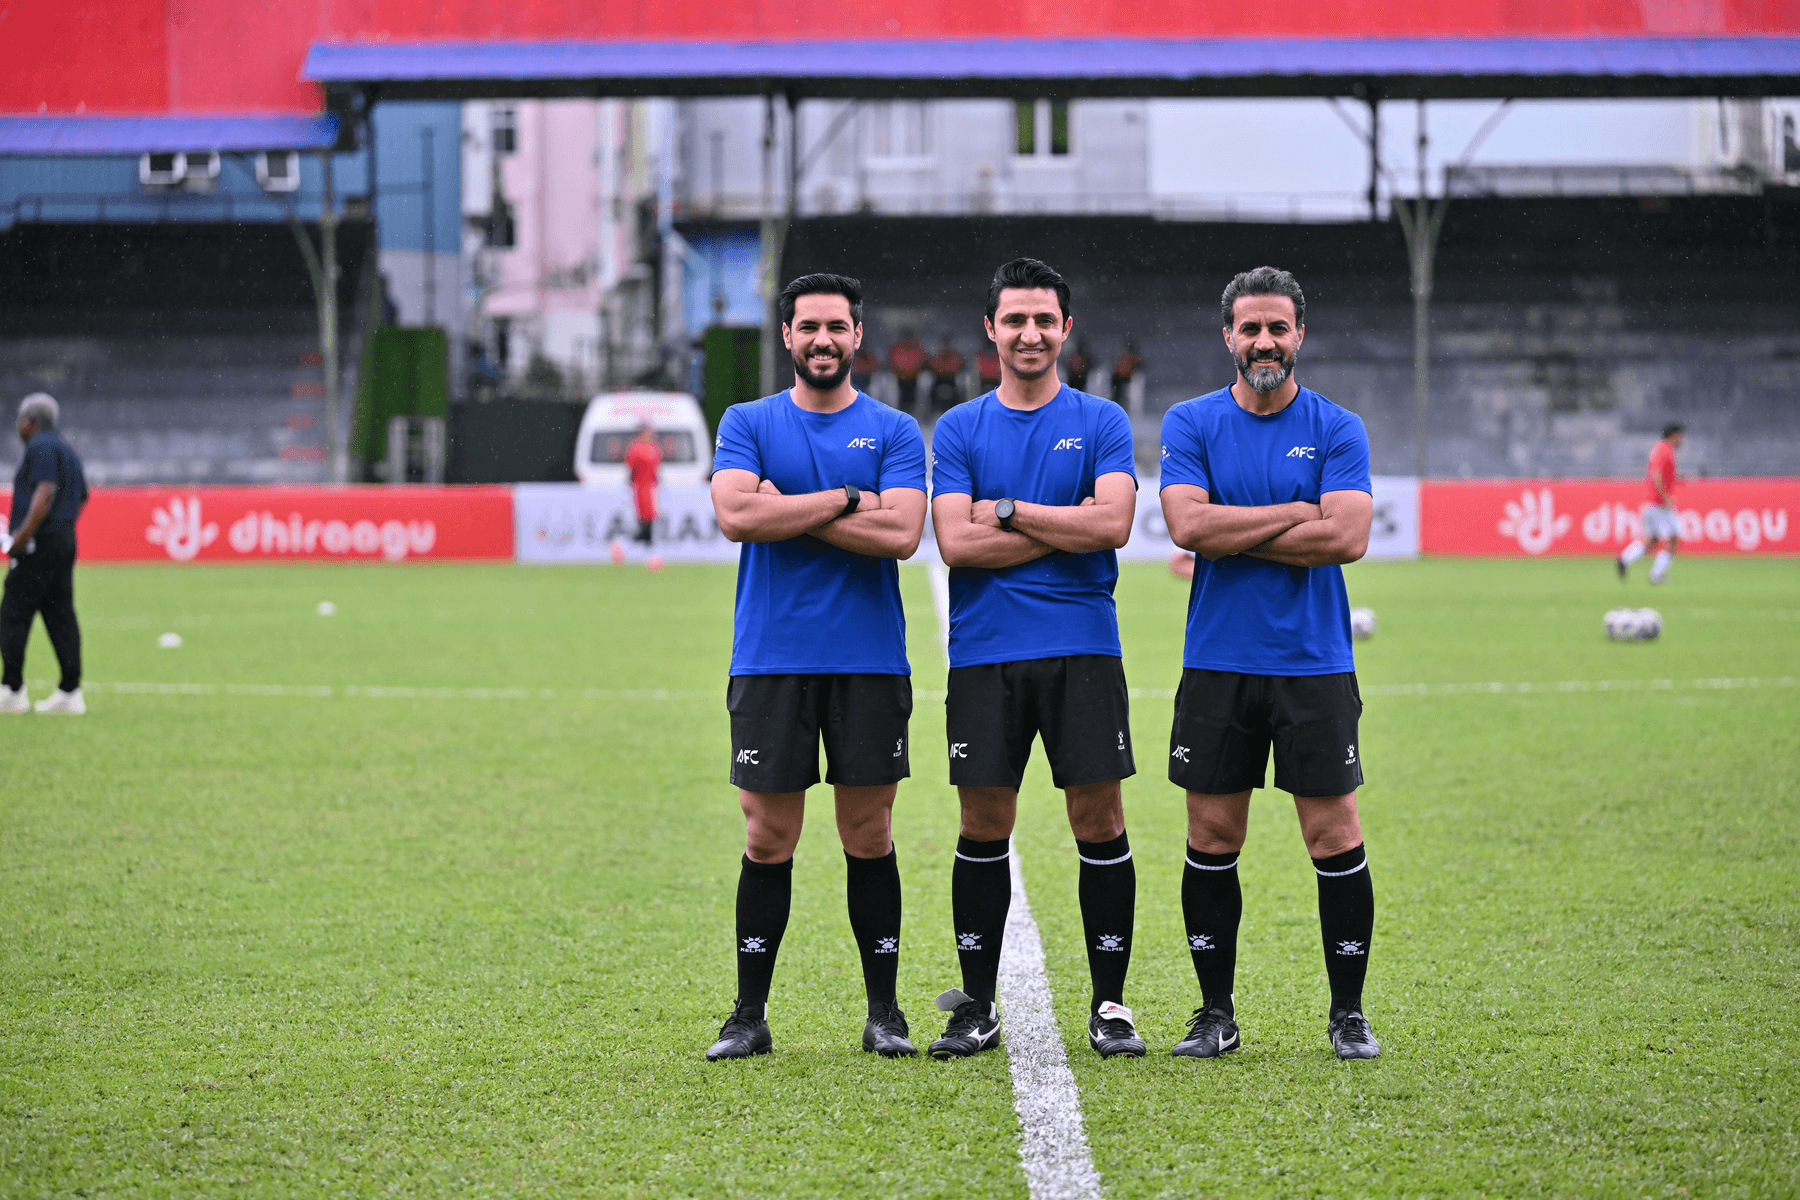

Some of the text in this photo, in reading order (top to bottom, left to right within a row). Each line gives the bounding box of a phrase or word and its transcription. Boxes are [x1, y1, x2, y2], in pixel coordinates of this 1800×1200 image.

[847, 437, 877, 450] AFC
[1053, 437, 1083, 451] AFC
[1285, 446, 1316, 460] AFC
[1582, 501, 1788, 551] dhaagu
[229, 510, 437, 560] dhiraagu
[736, 748, 760, 765] AFC
[1095, 944, 1124, 952] KELME
